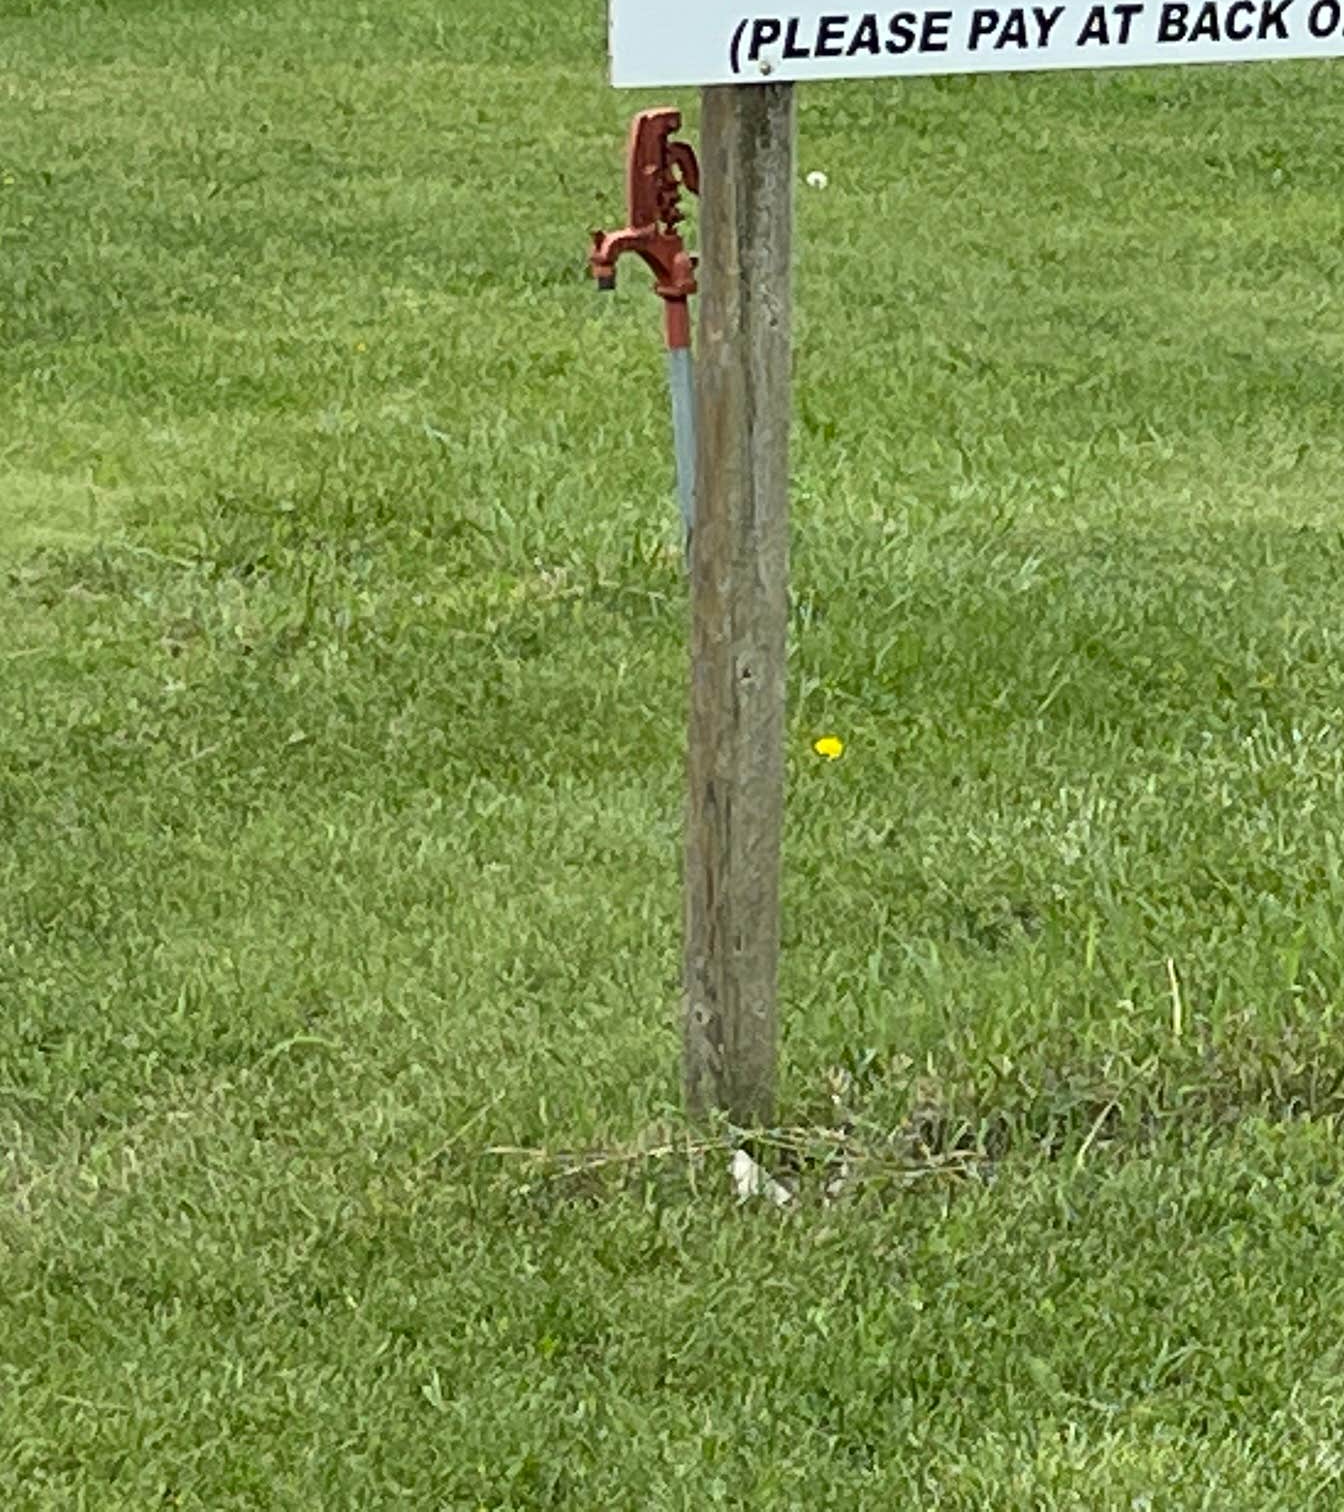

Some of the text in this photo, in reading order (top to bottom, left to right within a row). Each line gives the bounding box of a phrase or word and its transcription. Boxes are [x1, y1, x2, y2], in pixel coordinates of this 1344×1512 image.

[730, 10, 953, 74] (PLEASE
[967, 5, 1066, 53] PAY
[1076, 3, 1145, 47] AT
